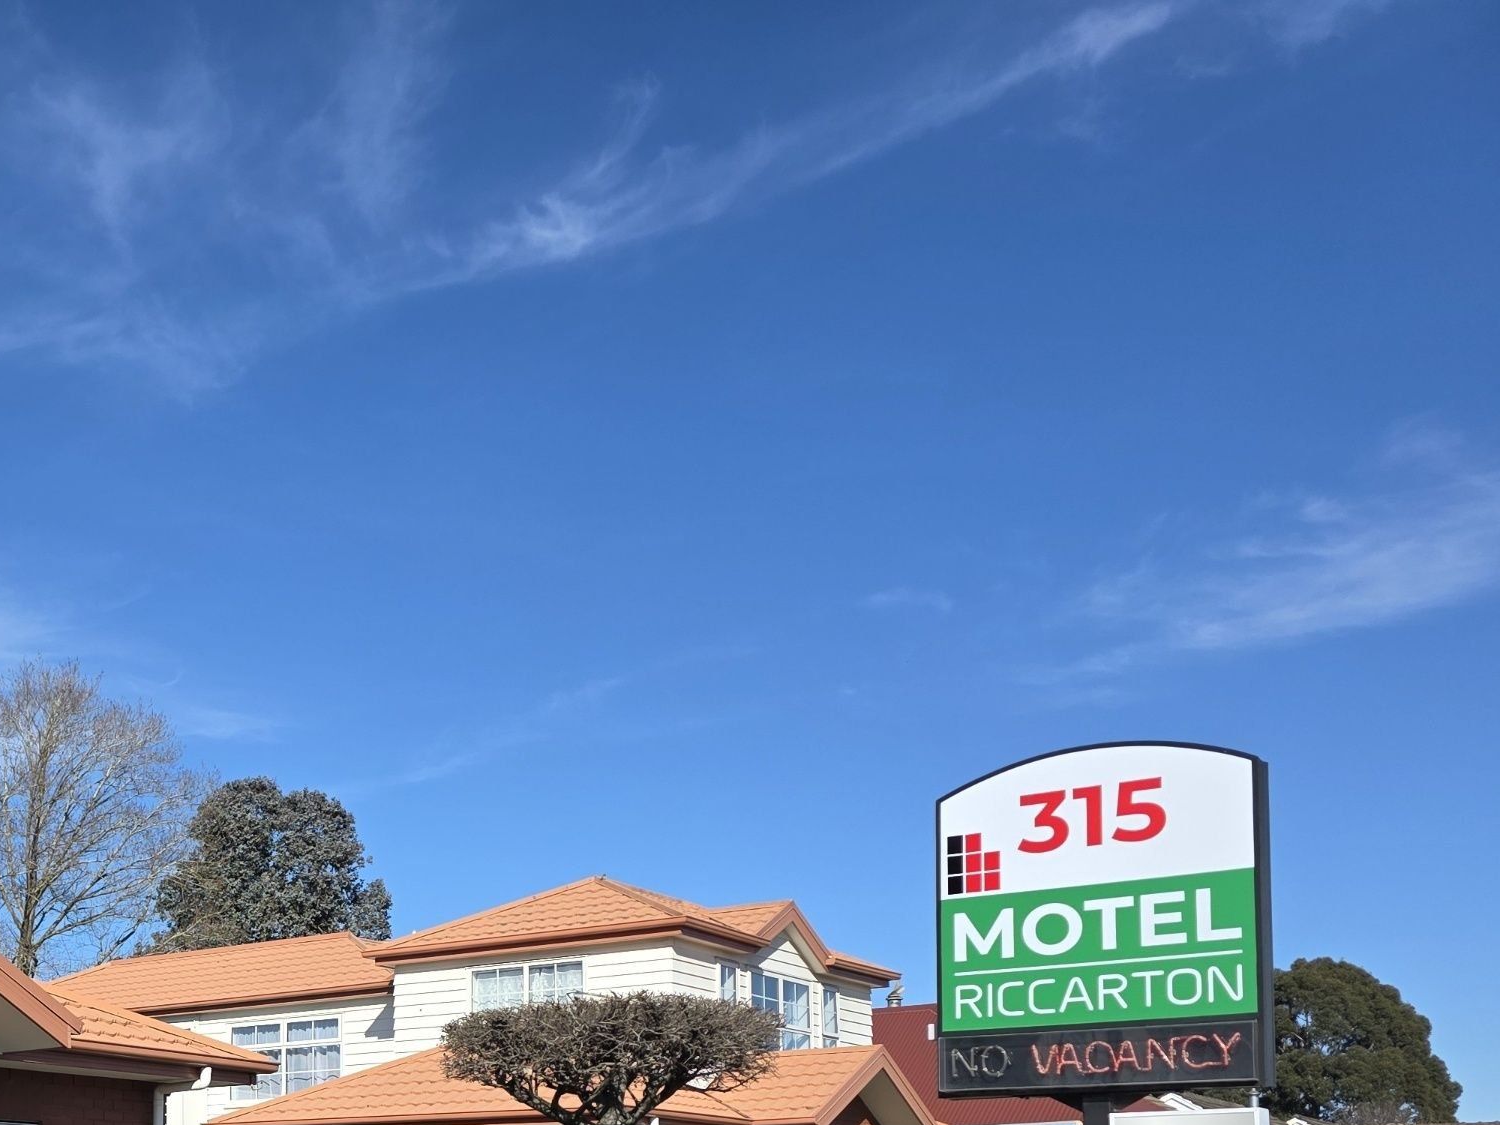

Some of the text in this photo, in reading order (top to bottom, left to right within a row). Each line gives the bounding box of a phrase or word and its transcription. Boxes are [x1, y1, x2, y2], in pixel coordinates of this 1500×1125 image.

[1017, 777, 1166, 853] 315
[953, 888, 1243, 962] MOTEL
[955, 964, 1244, 1019] RICCARTON
[951, 1032, 1241, 1077] NO VACANCY
